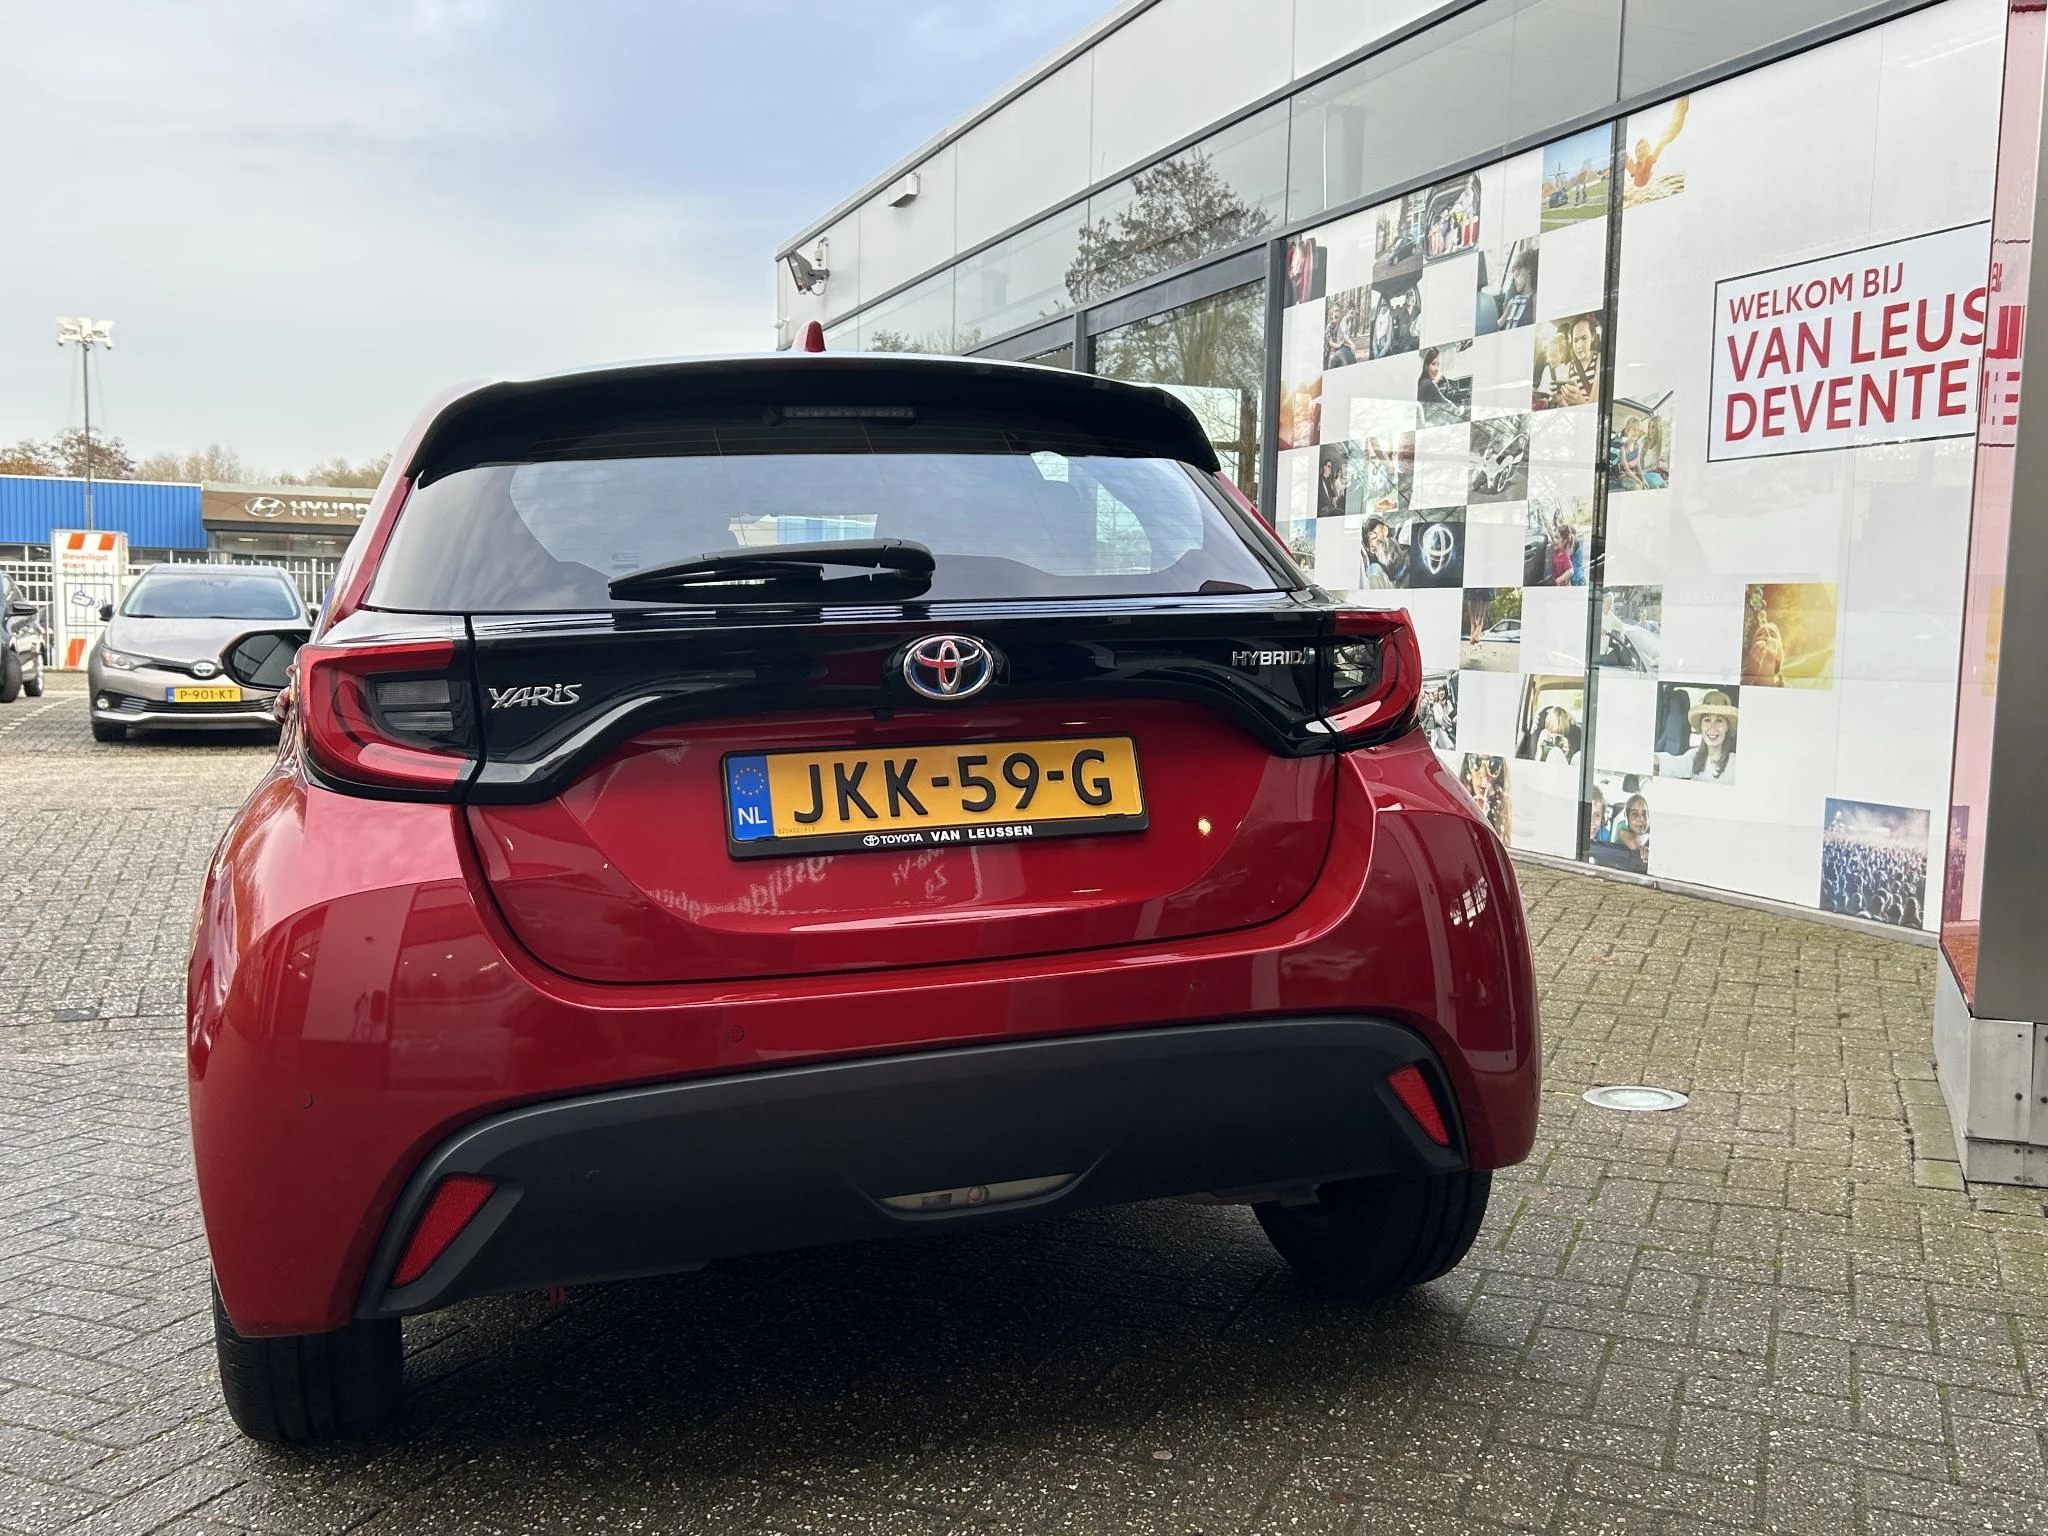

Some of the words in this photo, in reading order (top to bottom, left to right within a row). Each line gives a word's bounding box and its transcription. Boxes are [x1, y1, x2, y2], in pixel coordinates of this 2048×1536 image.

[1729, 274, 1852, 325] WELKOM
[1862, 262, 1904, 298] BIJ
[1727, 317, 1832, 382] VAN
[1850, 287, 1986, 364] LEUS
[1725, 358, 1981, 442] DEVENTE
[62, 553, 108, 563] Beveiligd
[1232, 650, 1305, 666] HYBRID
[180, 689, 234, 700] P-901-KT
[793, 749, 1112, 823] JKK-59-G
[738, 808, 767, 826] NL
[880, 834, 923, 845] TOYOTA
[930, 830, 960, 842] VAN
[967, 825, 1034, 840] LEUSSEN
